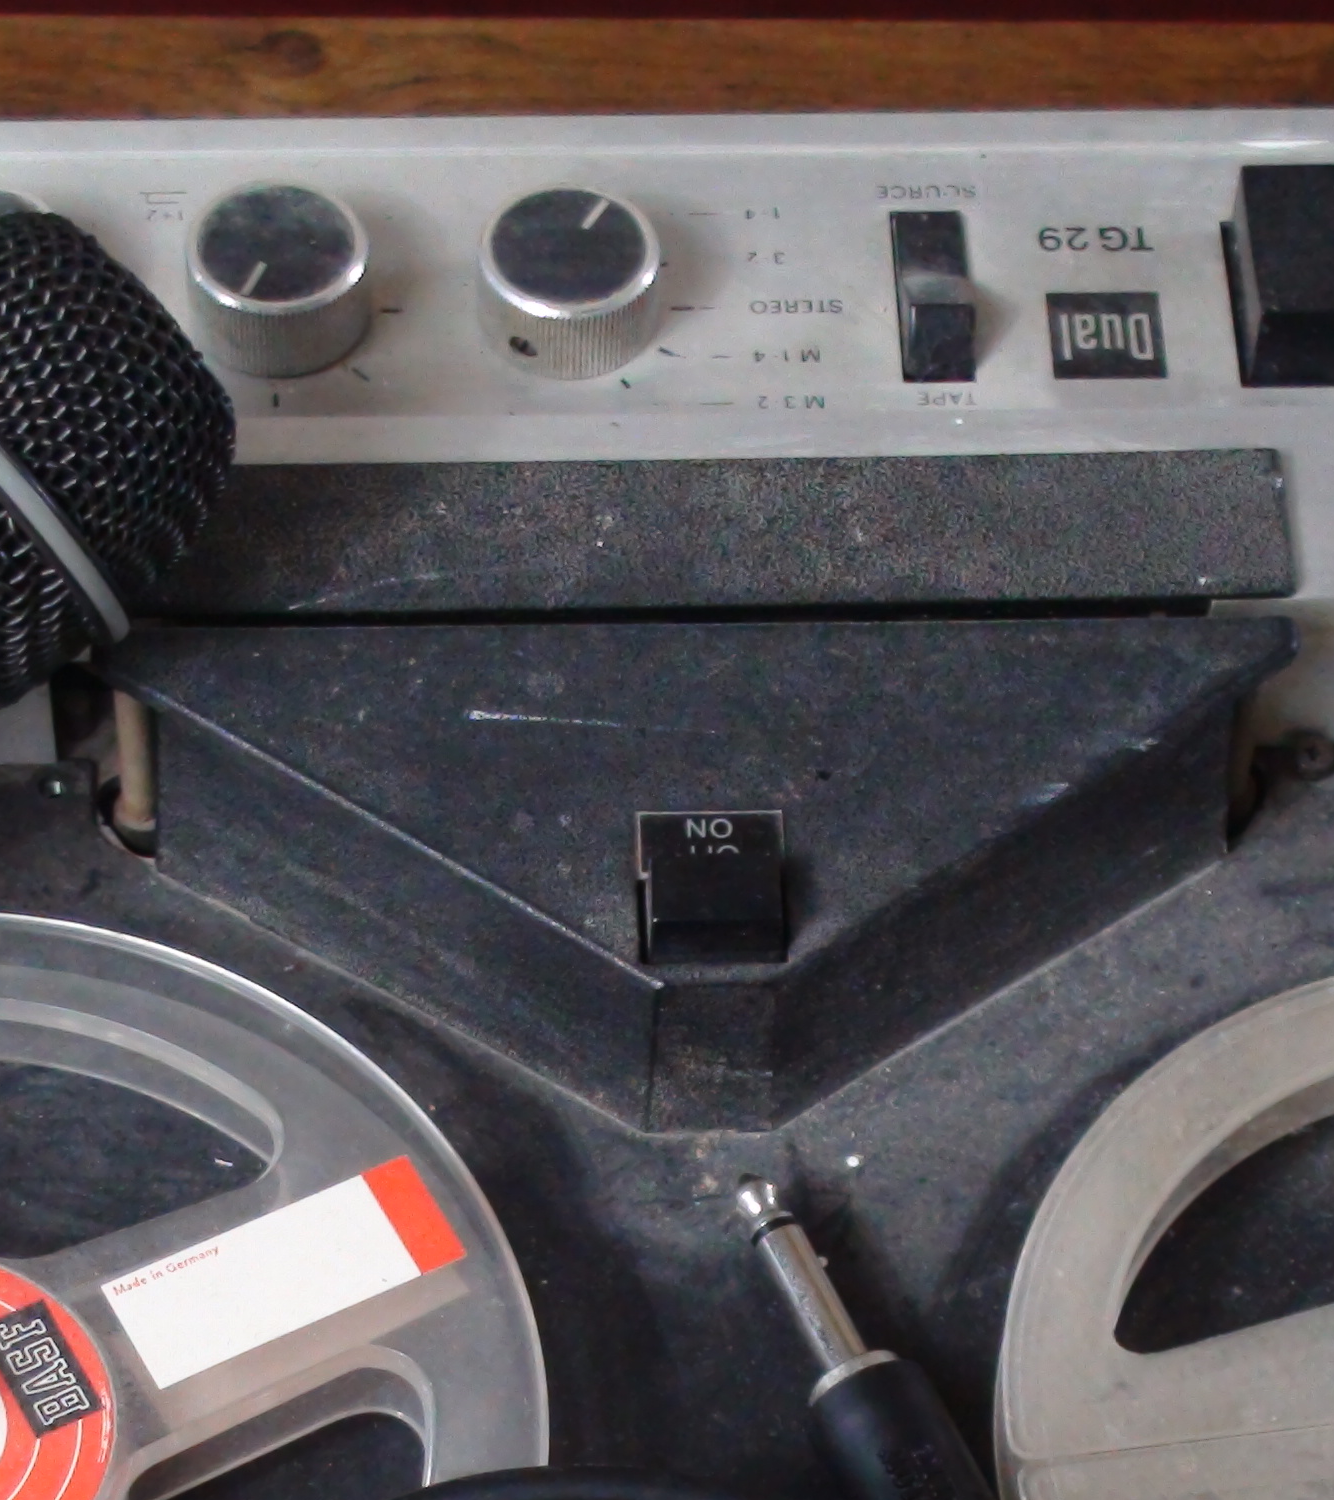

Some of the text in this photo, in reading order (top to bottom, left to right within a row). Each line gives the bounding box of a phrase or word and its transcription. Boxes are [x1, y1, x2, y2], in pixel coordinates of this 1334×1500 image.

[1036, 225, 1154, 253] TG 29
[748, 299, 844, 315] STEREO
[1058, 311, 1155, 361] Dual
[916, 390, 975, 407] TAPE
[684, 817, 734, 840] ON
[112, 1245, 220, 1296] Made in Germany
